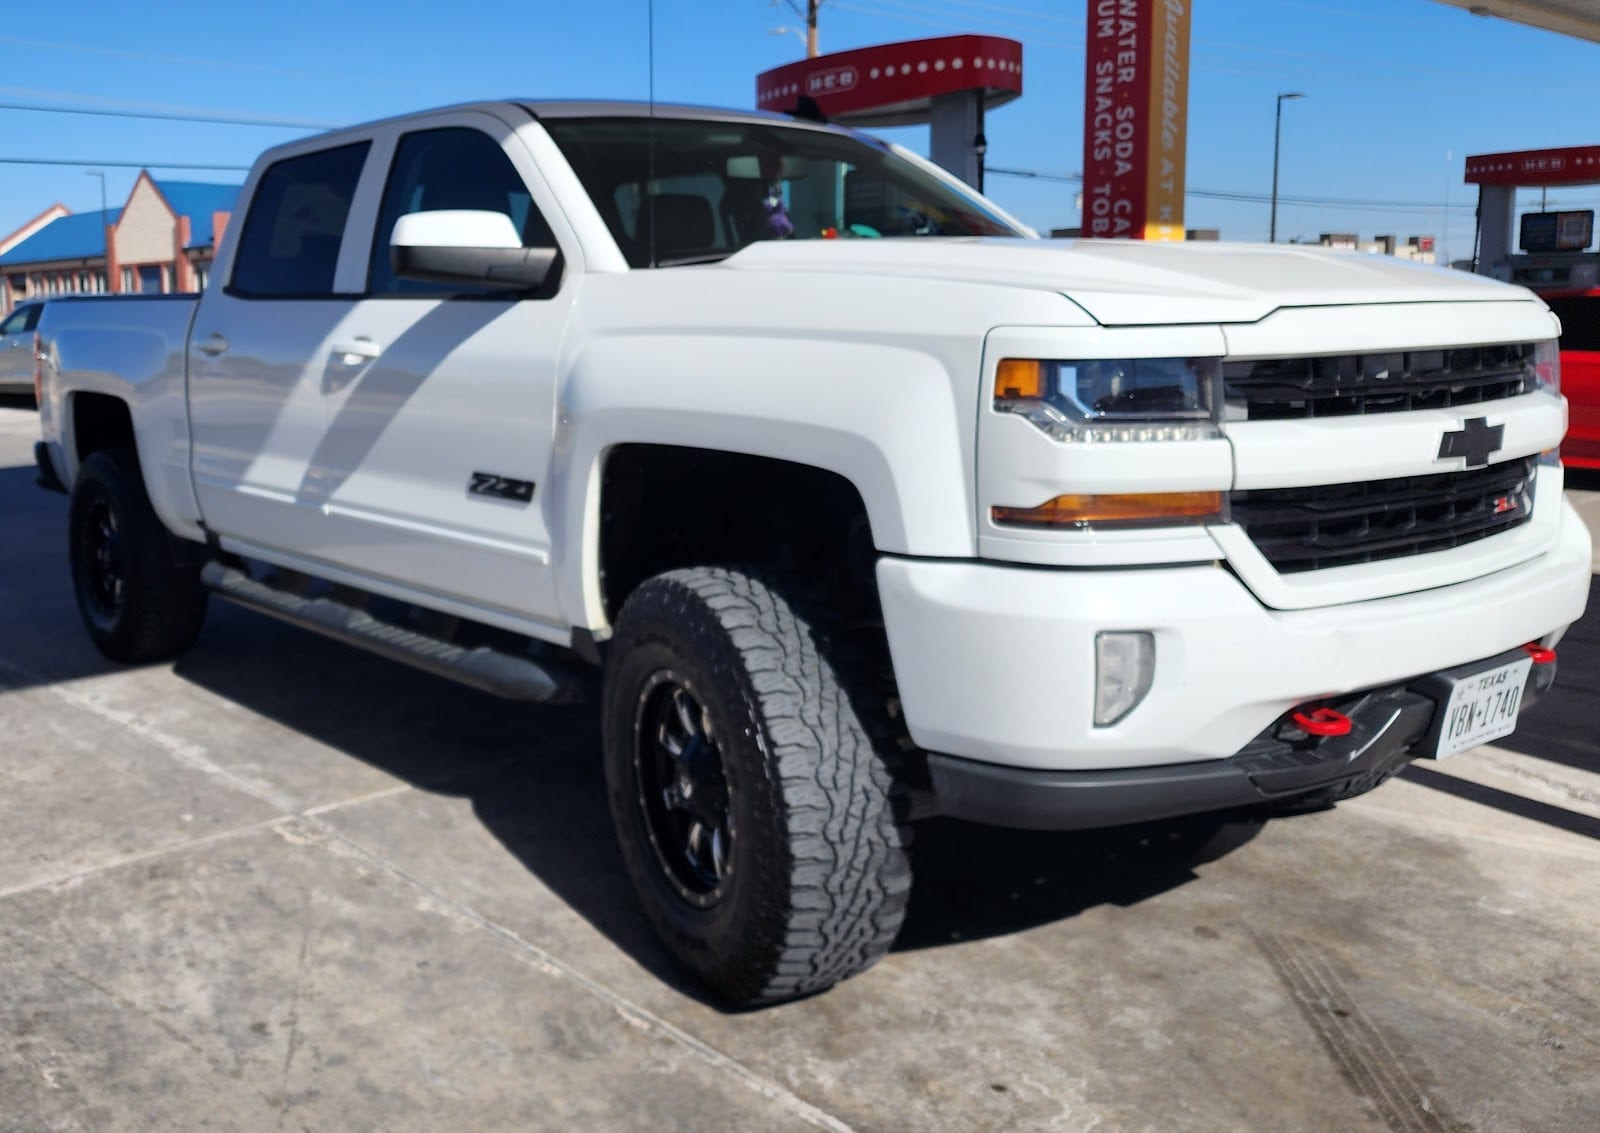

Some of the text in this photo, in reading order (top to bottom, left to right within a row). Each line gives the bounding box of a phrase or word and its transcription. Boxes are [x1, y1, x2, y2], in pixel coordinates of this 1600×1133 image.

[1094, 59, 1114, 161] SNACKS
[1112, 0, 1137, 239] WATER SODA CA
[1160, 157, 1174, 195] AT
[1092, 182, 1111, 238] TOB
[1480, 671, 1508, 690] TEXAS
